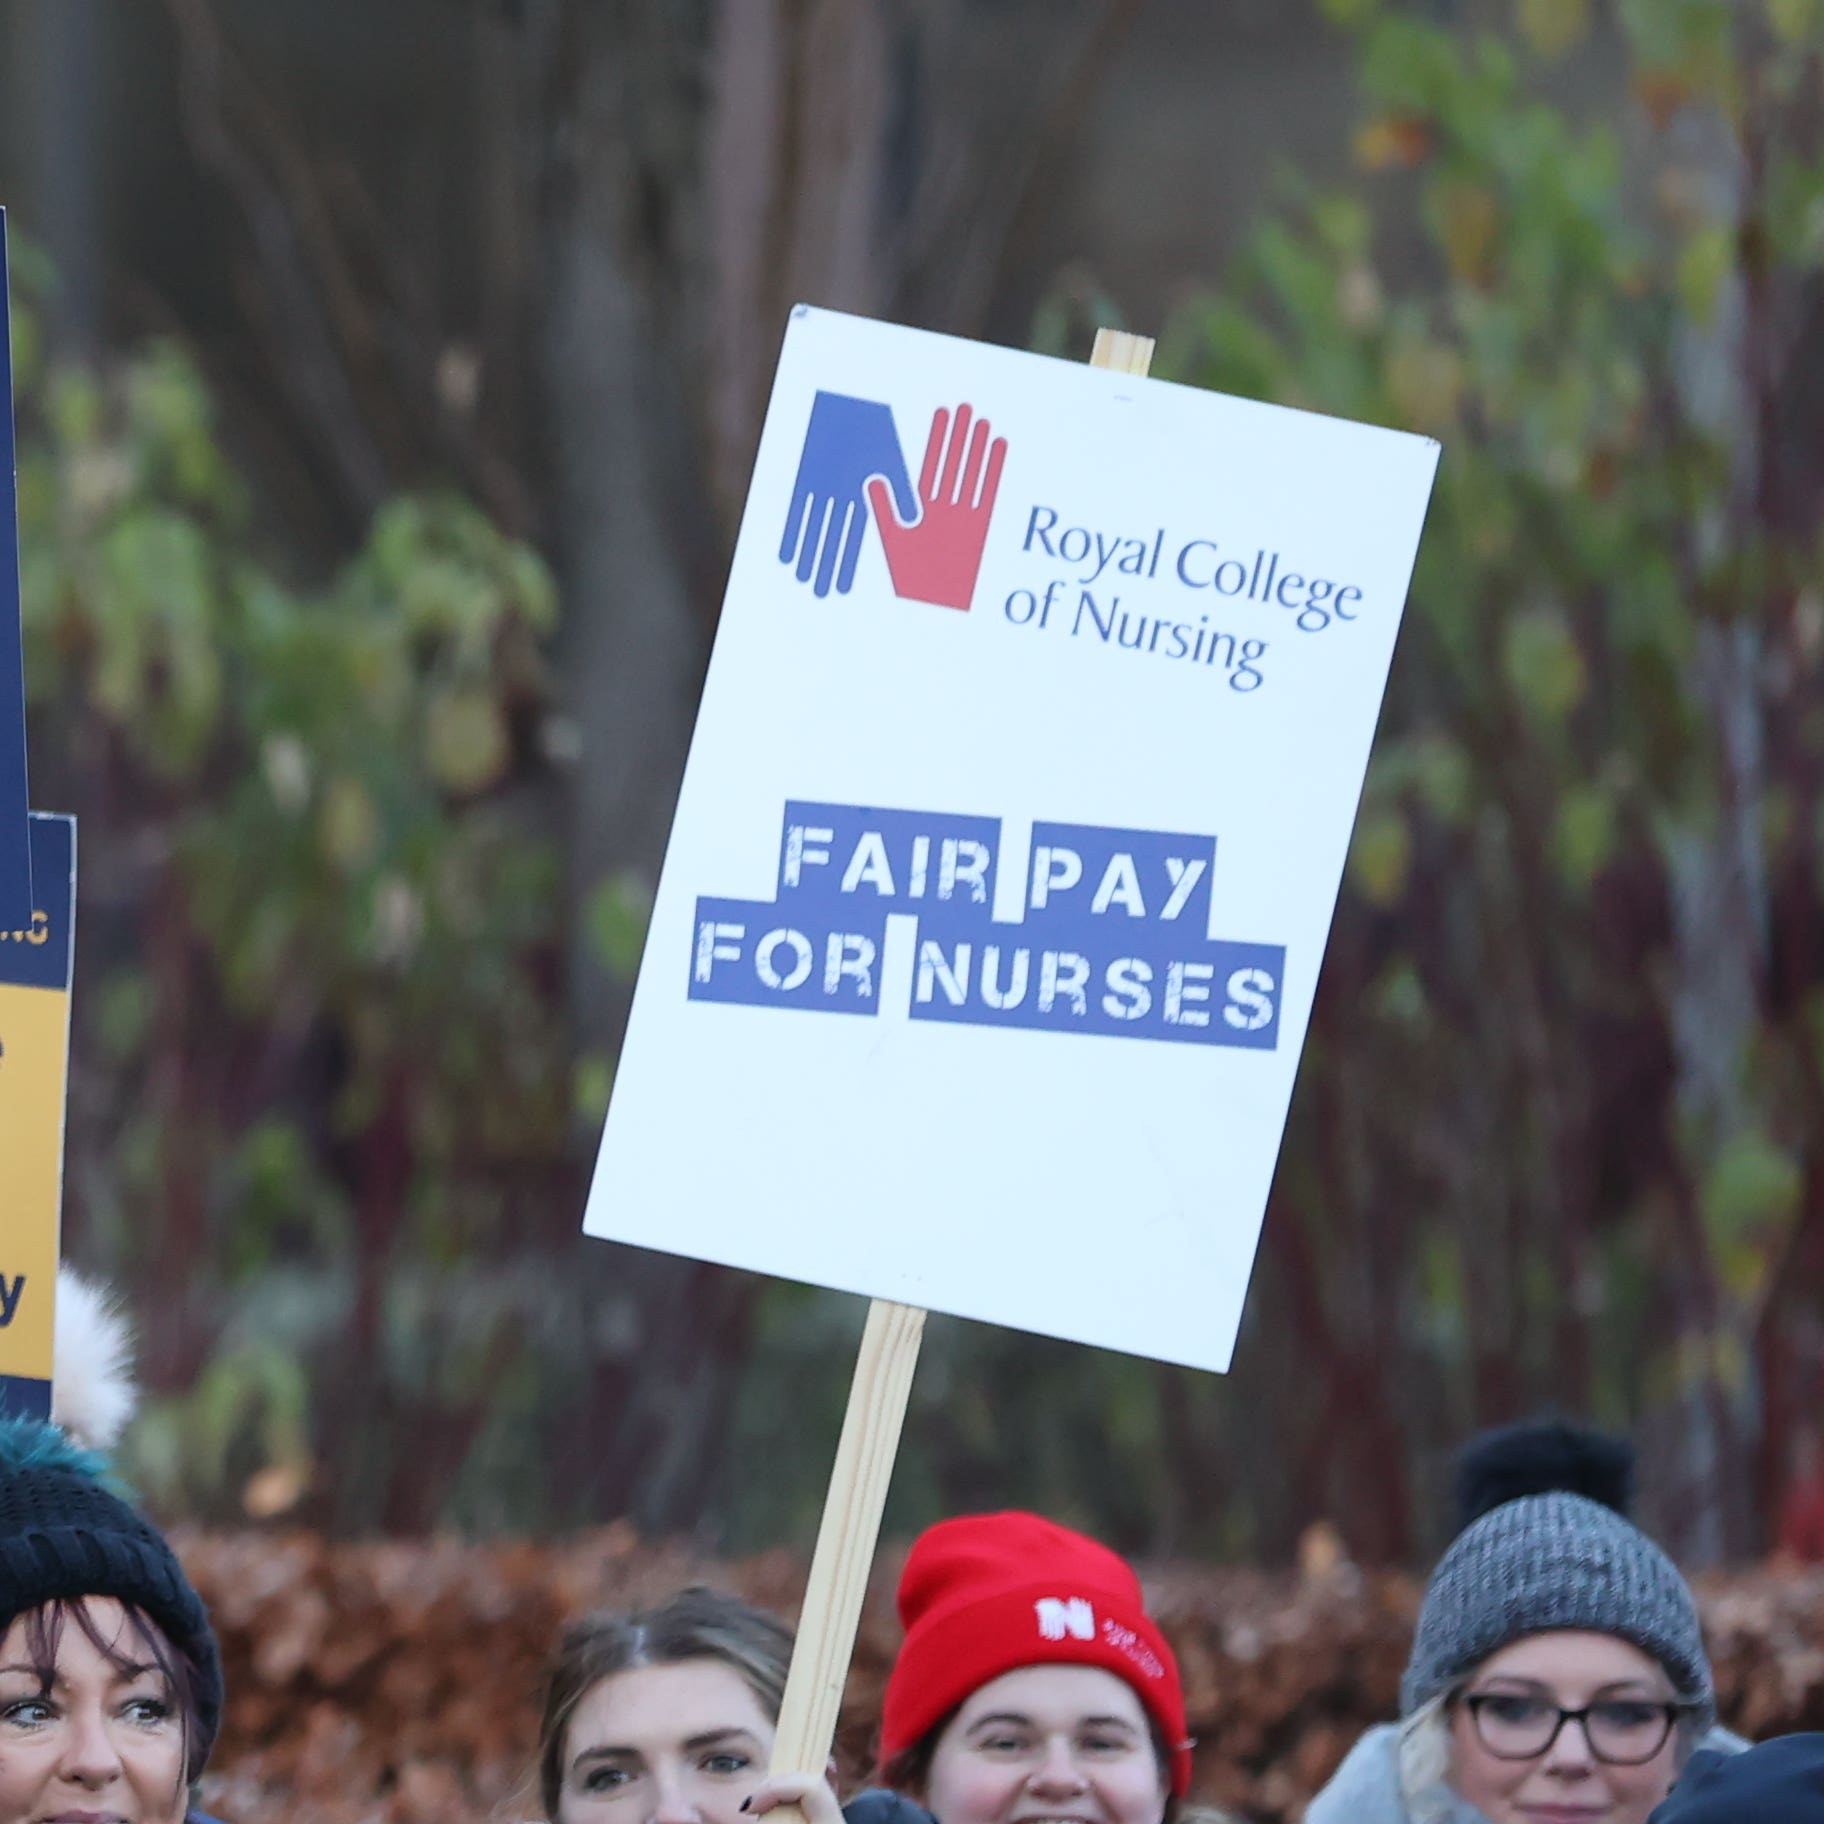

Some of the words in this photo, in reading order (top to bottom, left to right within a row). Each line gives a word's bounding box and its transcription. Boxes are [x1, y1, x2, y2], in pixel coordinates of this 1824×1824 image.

[1021, 506, 1164, 580] Royal
[1175, 540, 1363, 632] College
[1004, 581, 1068, 629] of
[1071, 589, 1270, 693] Nursing
[786, 825, 992, 904] FAIR
[1029, 846, 1207, 921] PAY
[695, 921, 877, 997] FOR
[916, 940, 1276, 1031] NURSES
